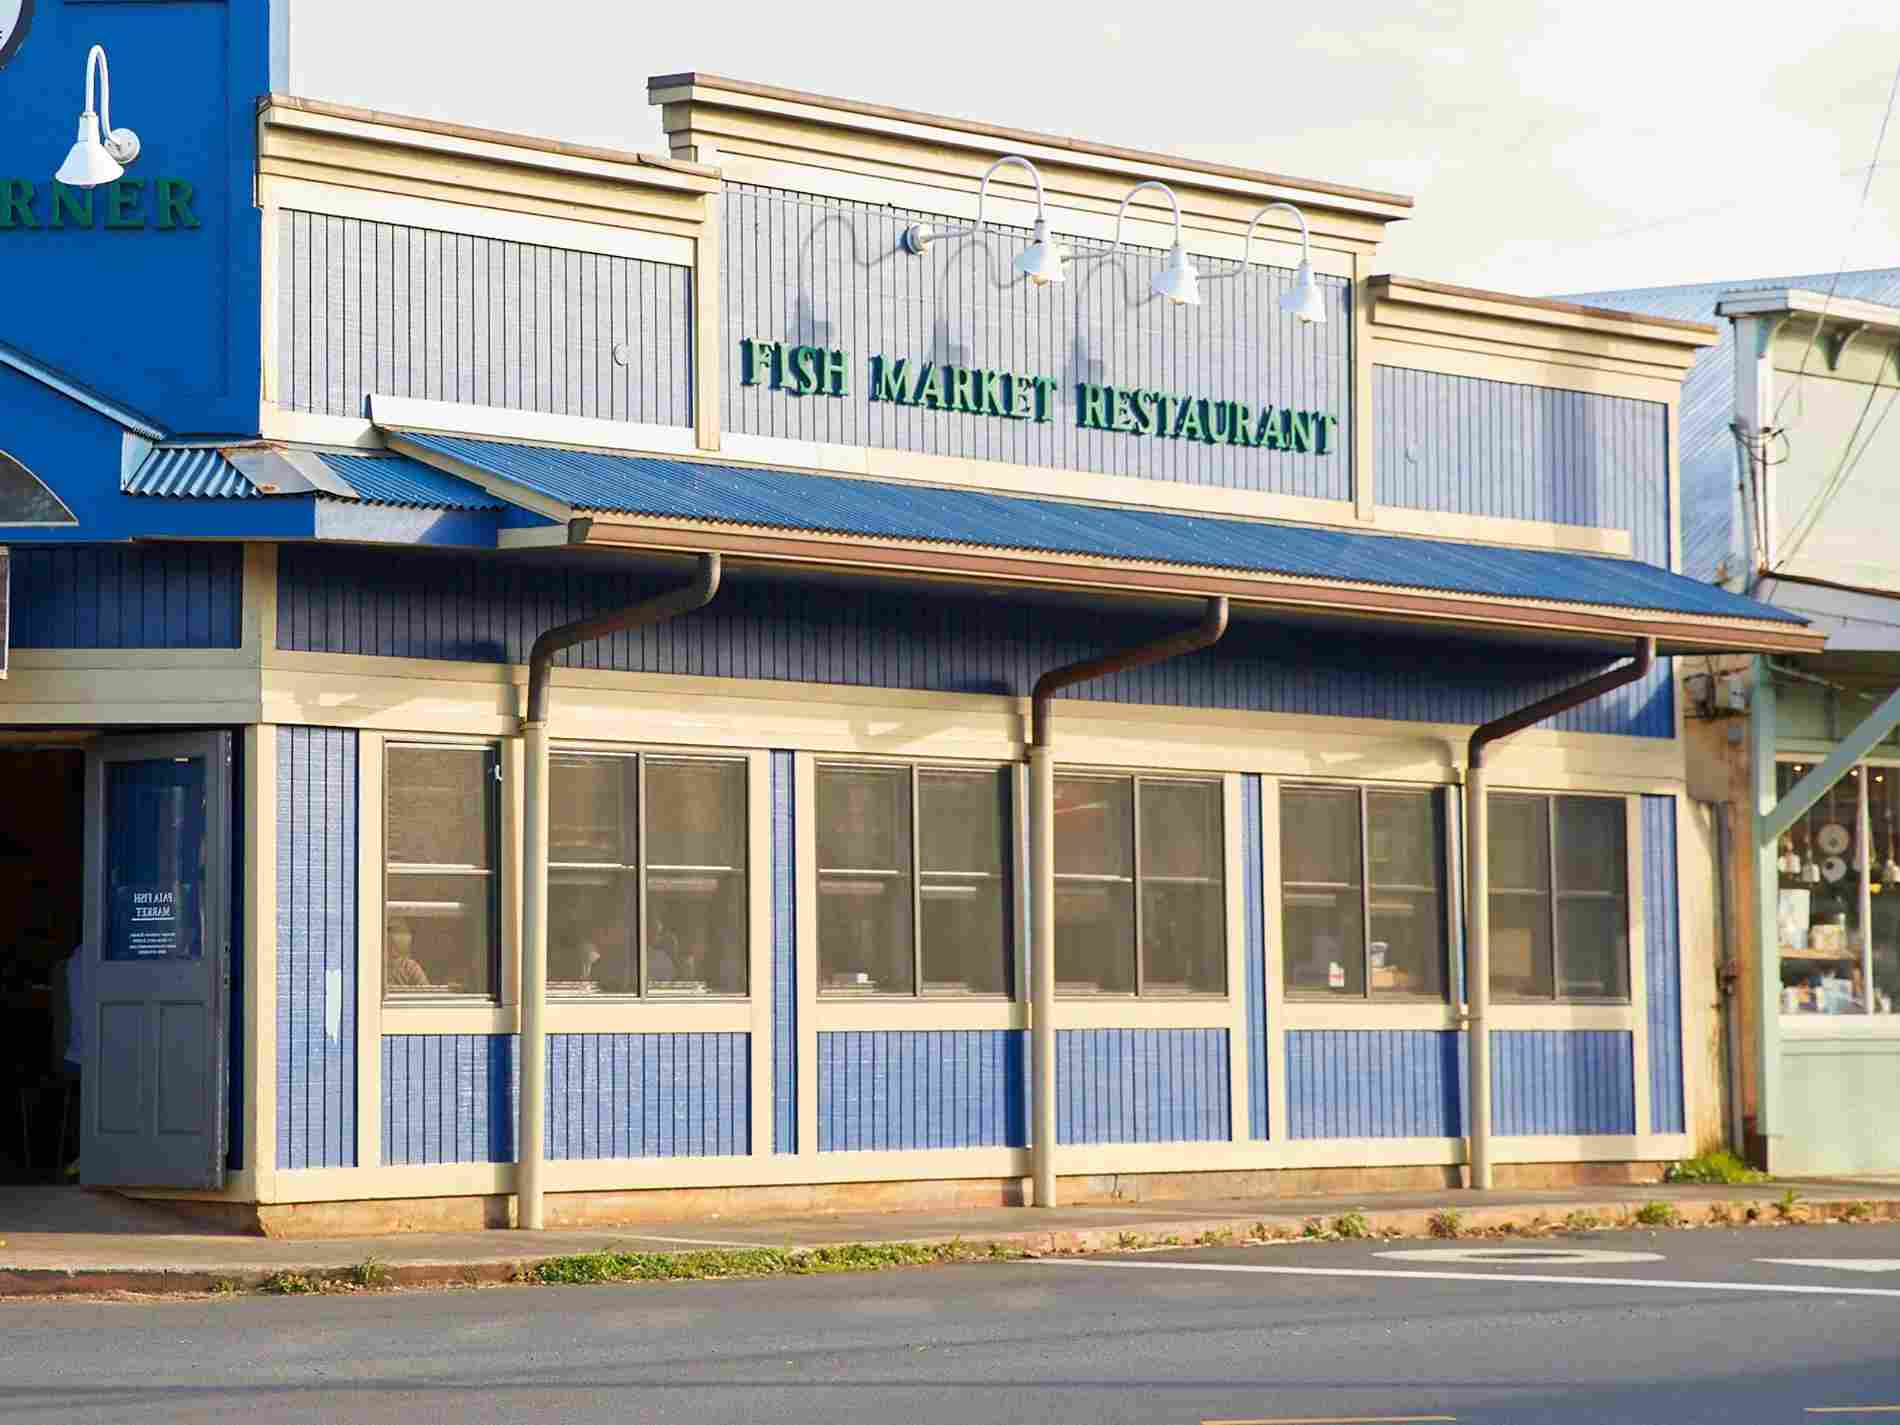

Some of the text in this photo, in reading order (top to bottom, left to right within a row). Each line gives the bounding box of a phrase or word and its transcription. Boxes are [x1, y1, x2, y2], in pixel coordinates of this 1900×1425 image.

[740, 337, 1338, 455] FISH MARKET RESTAURANT
